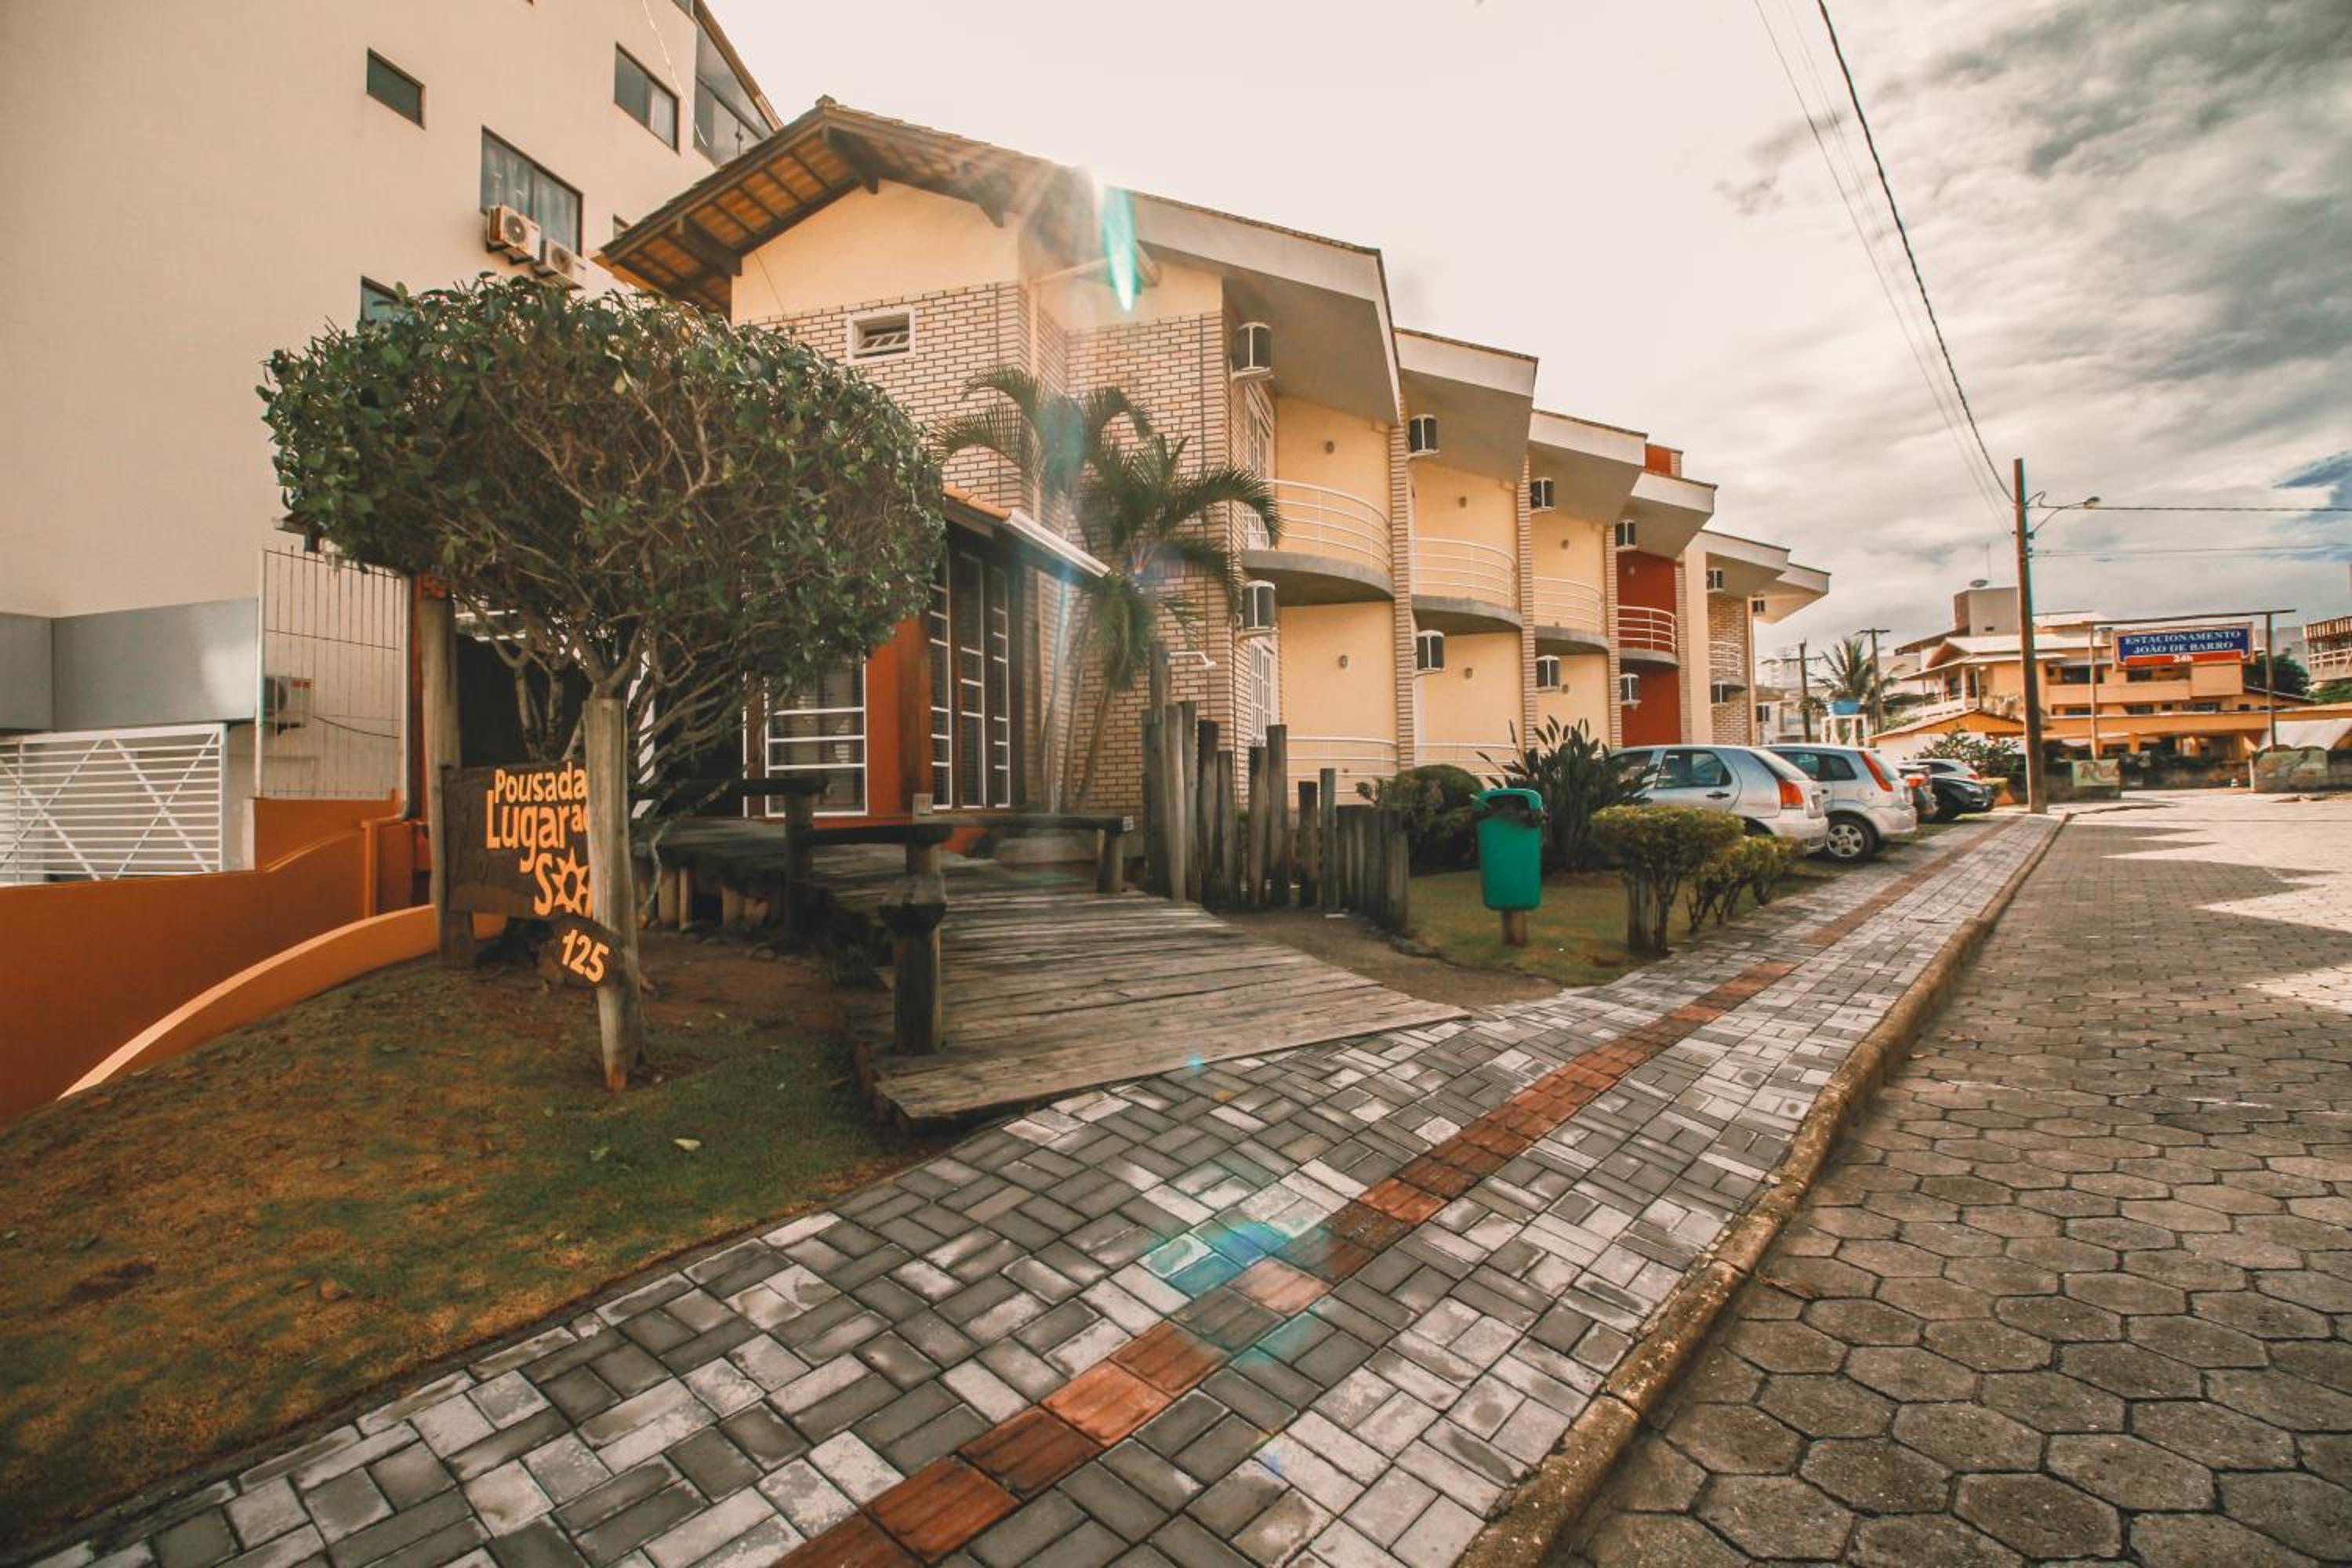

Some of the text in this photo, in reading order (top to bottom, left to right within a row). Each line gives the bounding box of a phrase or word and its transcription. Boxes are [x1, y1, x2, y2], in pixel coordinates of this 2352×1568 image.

[2125, 630, 2241, 644] ESTACIONAMENTO
[2133, 641, 2233, 654] JOÃO DE BARRO
[495, 761, 588, 803] Pousada
[486, 789, 571, 873] Lugar
[562, 928, 609, 982] 125
